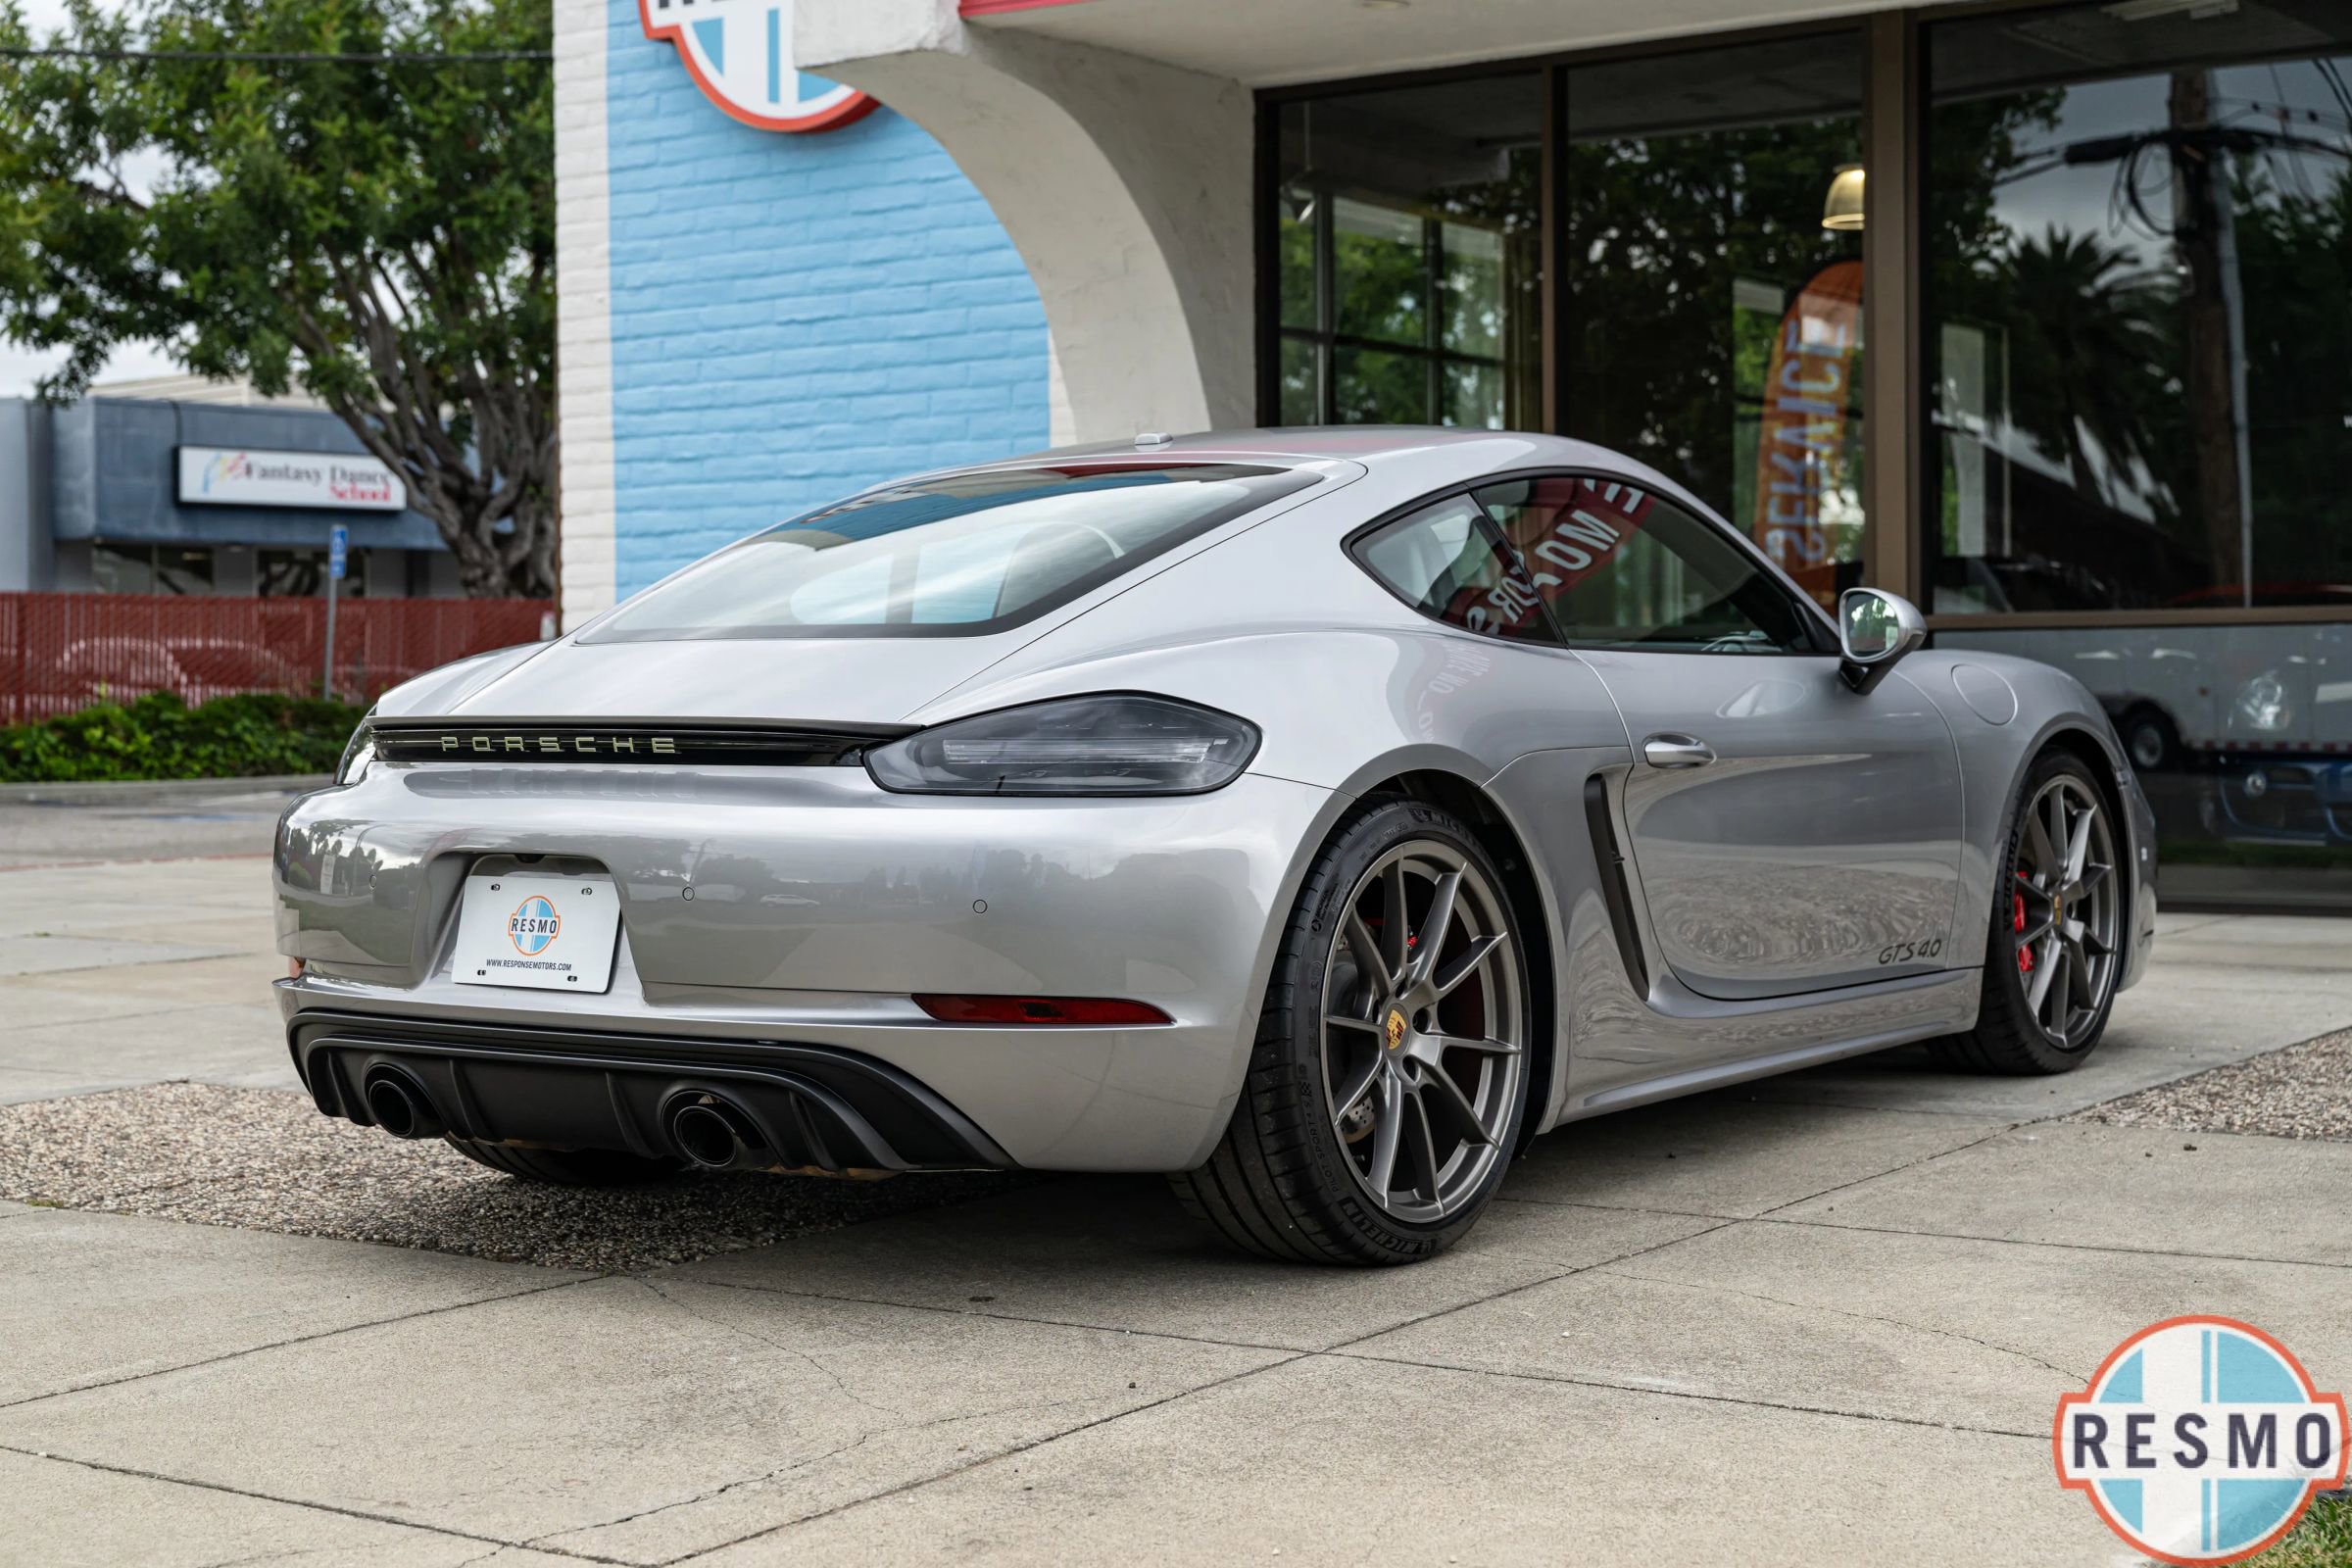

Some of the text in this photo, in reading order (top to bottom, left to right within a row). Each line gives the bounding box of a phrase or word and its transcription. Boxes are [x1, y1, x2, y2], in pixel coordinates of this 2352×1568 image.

[441, 736, 676, 754] PORSCHE
[511, 917, 558, 934] RESMO
[1878, 942, 1916, 965] GTS
[486, 958, 572, 972] WWW.RESPONSEMOTORS.COM
